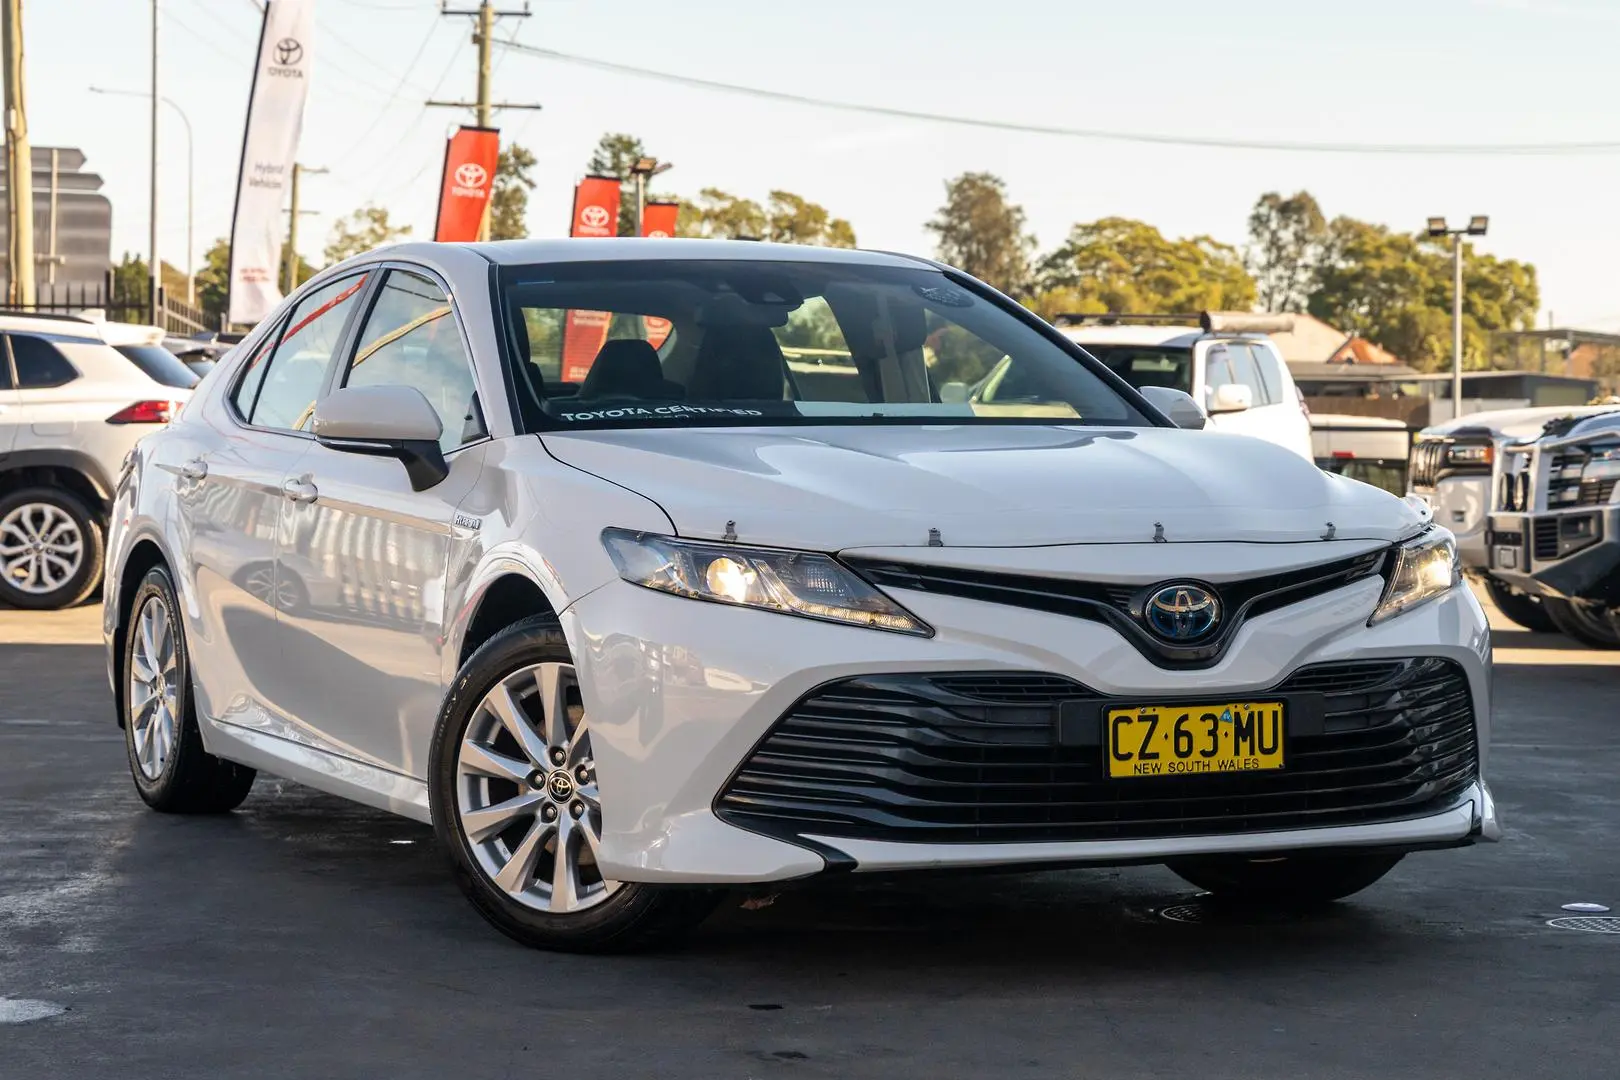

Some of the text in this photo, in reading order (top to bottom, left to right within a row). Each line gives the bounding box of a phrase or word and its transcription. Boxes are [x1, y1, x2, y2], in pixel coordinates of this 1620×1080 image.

[561, 405, 763, 422] TOYOTA CERTIFIED
[1134, 758, 1259, 775] NEW SOUTH WALES
